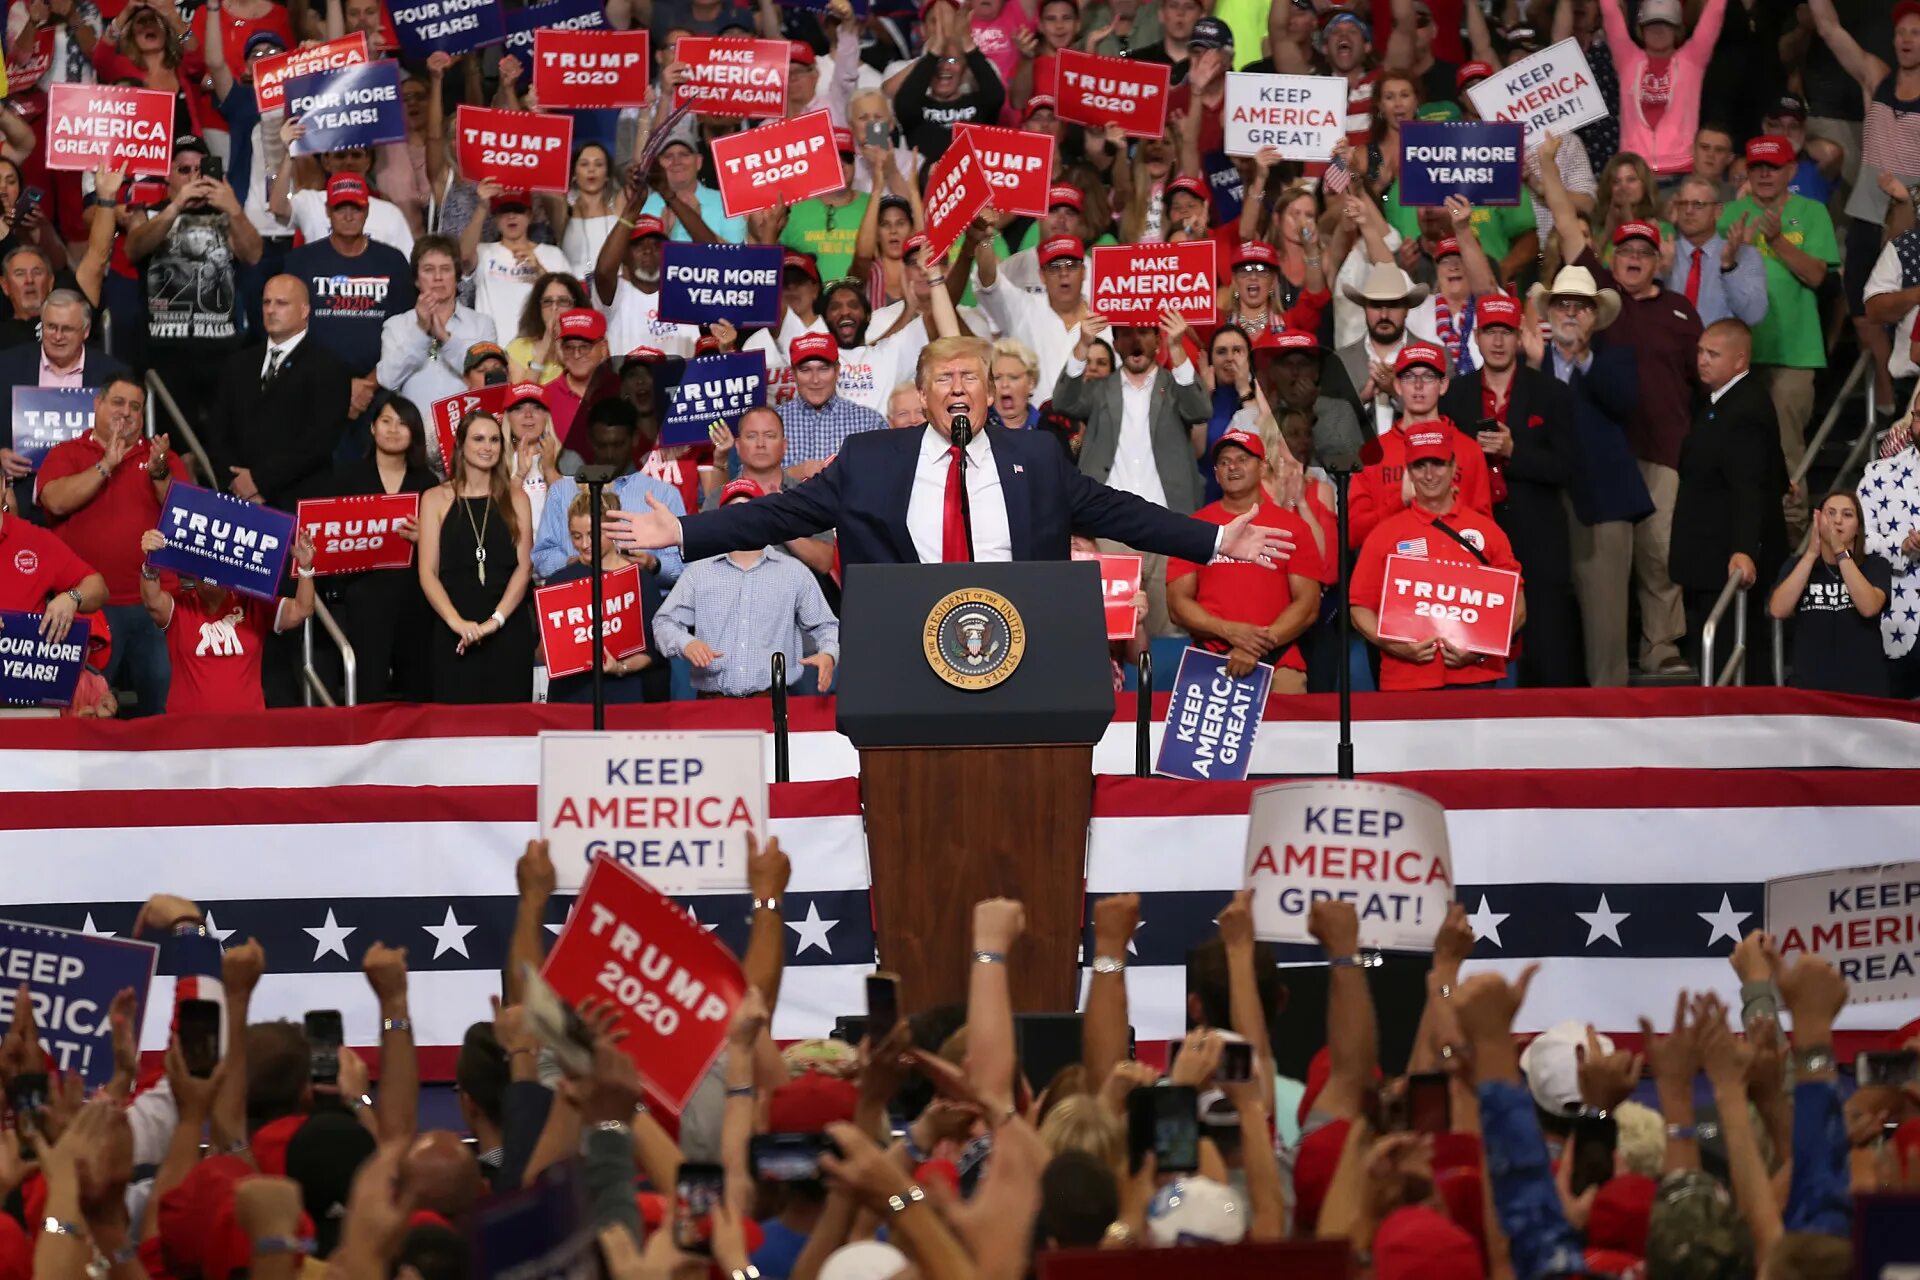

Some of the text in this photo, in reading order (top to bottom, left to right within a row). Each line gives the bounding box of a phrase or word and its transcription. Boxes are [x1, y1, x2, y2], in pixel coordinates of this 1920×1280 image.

[393, 4, 441, 26] FOUR
[415, 14, 479, 41] YEARS!
[505, 28, 538, 48] FOU
[287, 44, 331, 64] MAKE
[543, 51, 641, 69] TRUMP
[708, 49, 755, 63] MAKE
[260, 50, 363, 88] AMERICA
[562, 70, 620, 86] 2020
[680, 64, 782, 88] AMERICA
[1506, 62, 1554, 96] KEEP
[677, 84, 782, 105] GREAT AGAIN
[1063, 70, 1159, 99] TRUMP
[1260, 87, 1312, 103] KEEP
[88, 100, 137, 115] MAKE
[290, 85, 397, 115] FOUR MORE
[1081, 92, 1136, 114] 2020
[1495, 71, 1589, 123] AMERICA
[313, 108, 379, 131] YEARS!
[922, 105, 977, 123] TRUMP
[1232, 105, 1337, 127] AMERICA
[1524, 96, 1585, 136] GREAT!
[54, 115, 167, 142] AMERICA
[463, 128, 562, 152] TRUMP
[1248, 128, 1321, 147] GREAT!
[54, 138, 167, 160] GREAT AGAIN
[481, 150, 540, 168] 2020
[725, 135, 827, 175] TRUMP
[974, 149, 1043, 172] UMP
[1405, 147, 1516, 162] FOUR MORE
[751, 159, 809, 188] 2020
[928, 154, 971, 214] RUMP
[984, 170, 1020, 189] 20
[1427, 166, 1494, 183] YEARS!
[932, 184, 967, 228] 2020
[666, 265, 777, 286] FOUR MORE
[1130, 255, 1179, 273] MAKE
[312, 276, 390, 303] Trump
[1097, 272, 1211, 295] AMERICA
[687, 288, 754, 307] YEARS!
[1097, 294, 1211, 313] GREAT AGAIN
[664, 375, 760, 404] TRUMP
[676, 393, 754, 415] PENCE
[23, 410, 96, 428] TRU
[447, 400, 461, 436] GRE
[33, 428, 83, 439] PEN
[172, 506, 279, 552] TRUMP
[306, 517, 409, 539] TRUMP
[174, 527, 265, 565] PENCE
[325, 535, 384, 554] 2020
[184, 543, 217, 561] AMERICA
[219, 553, 244, 568] GREAT
[244, 562, 272, 577] AGAIN!
[973, 592, 983, 600] OF
[984, 594, 998, 605] THE
[1394, 578, 1506, 609] TRUMP
[1802, 594, 1850, 606] PENC
[1809, 582, 1850, 597] RUM
[927, 592, 971, 637] PRESIDENT
[1000, 603, 1022, 644] UNITED
[1414, 601, 1479, 624] 2020
[37, 641, 82, 662] MORE
[932, 655, 941, 666] OF
[3, 659, 59, 683] YEARS!
[941, 666, 966, 685] SEAL
[983, 653, 1018, 685] STATES
[1176, 683, 1205, 743] KEEP
[1191, 664, 1234, 778] AMERICA
[1219, 683, 1255, 764] GREAT!
[606, 757, 704, 786] KEEP
[552, 796, 754, 830] AMERICA
[1304, 806, 1405, 838] KEEP
[584, 839, 725, 868] GREAT!
[1250, 844, 1450, 889] AMERICA
[1279, 888, 1423, 925] GAT!
[1829, 881, 1920, 915] KEEP
[1780, 912, 1920, 958] AMERI
[589, 902, 729, 1023] TRUMP
[1839, 951, 1920, 985] REA
[596, 961, 680, 1037] 2020
